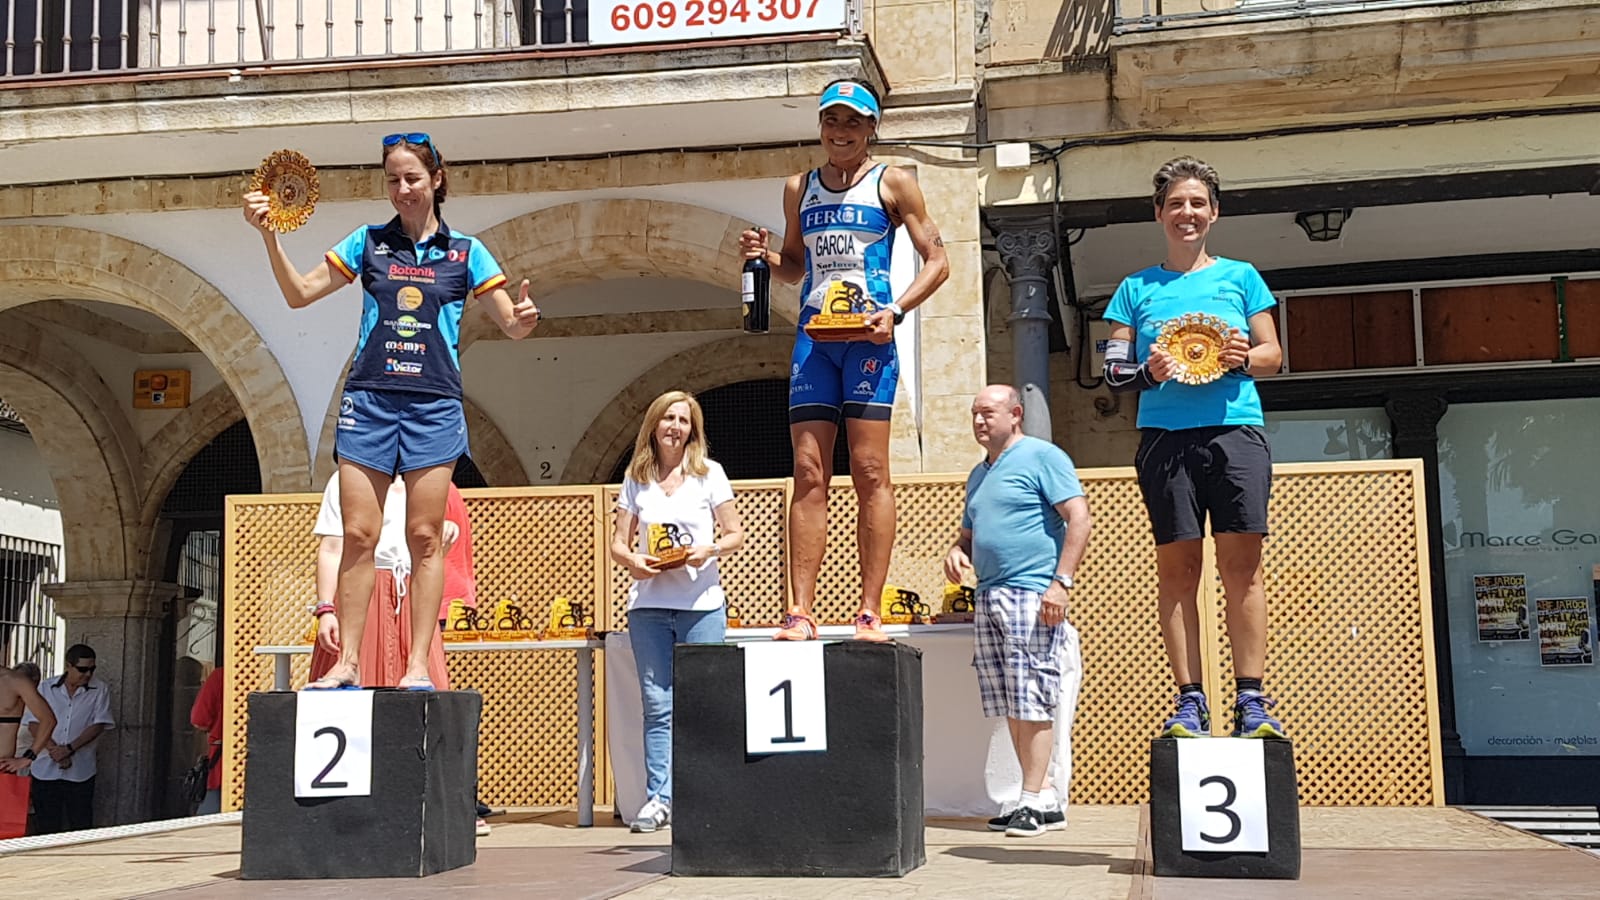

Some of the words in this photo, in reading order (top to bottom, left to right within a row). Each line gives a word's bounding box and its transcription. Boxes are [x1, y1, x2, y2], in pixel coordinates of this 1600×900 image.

[610, 1, 677, 31] 609
[684, 0, 750, 26] 294
[757, 0, 821, 21] 307
[815, 234, 856, 257] GARCIA
[388, 264, 436, 278] Botanik
[540, 461, 552, 480] 2
[1459, 531, 1541, 548] Marce
[1552, 529, 1600, 545] Ga
[769, 679, 805, 744] 1
[1554, 735, 1597, 746] muebles
[311, 726, 348, 789] 2
[1199, 775, 1242, 845] 3
